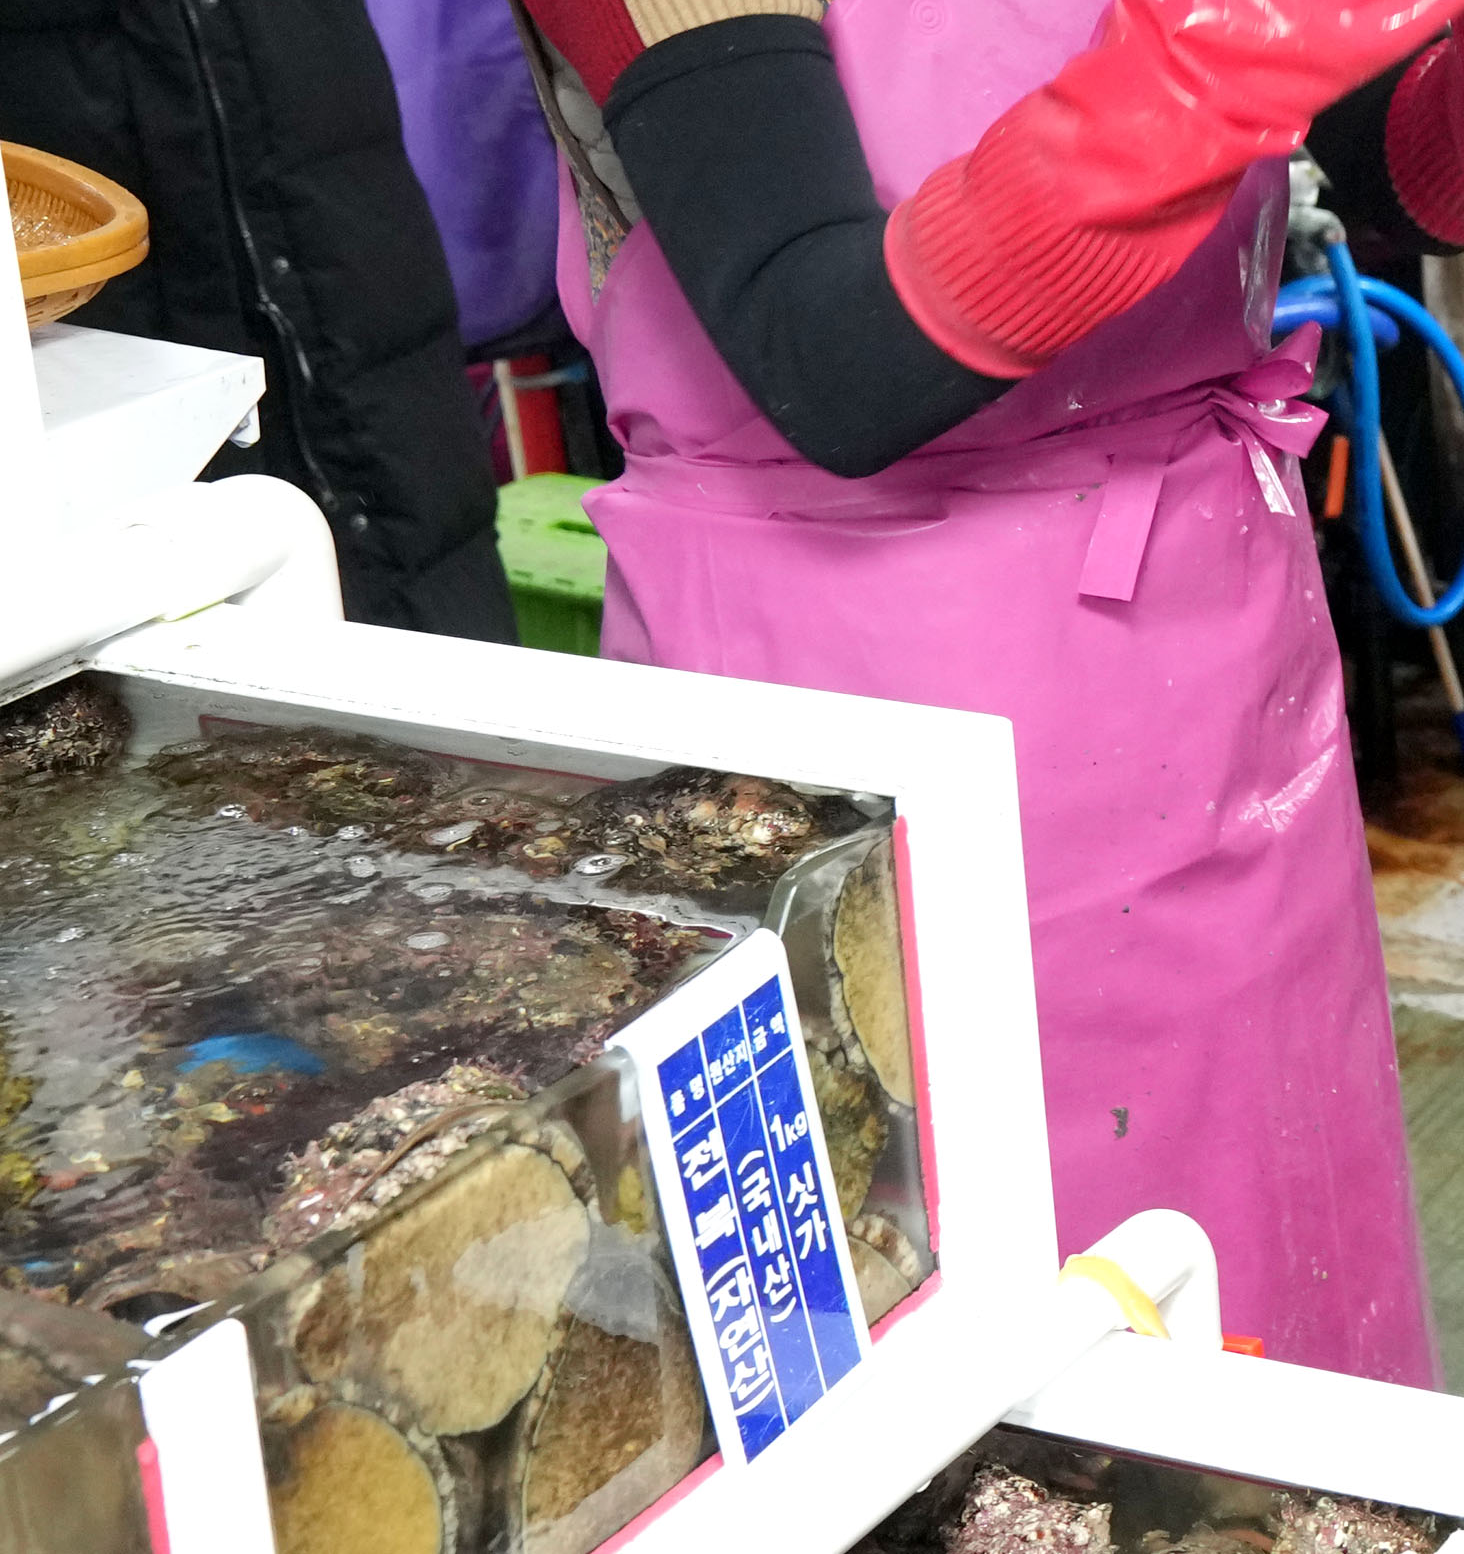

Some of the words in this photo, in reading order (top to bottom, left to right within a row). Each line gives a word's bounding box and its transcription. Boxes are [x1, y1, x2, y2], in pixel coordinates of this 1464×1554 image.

[709, 1040, 750, 1086] 원산지
[770, 1110, 809, 1153] 1kg
[737, 1149, 797, 1324] (국내산)
